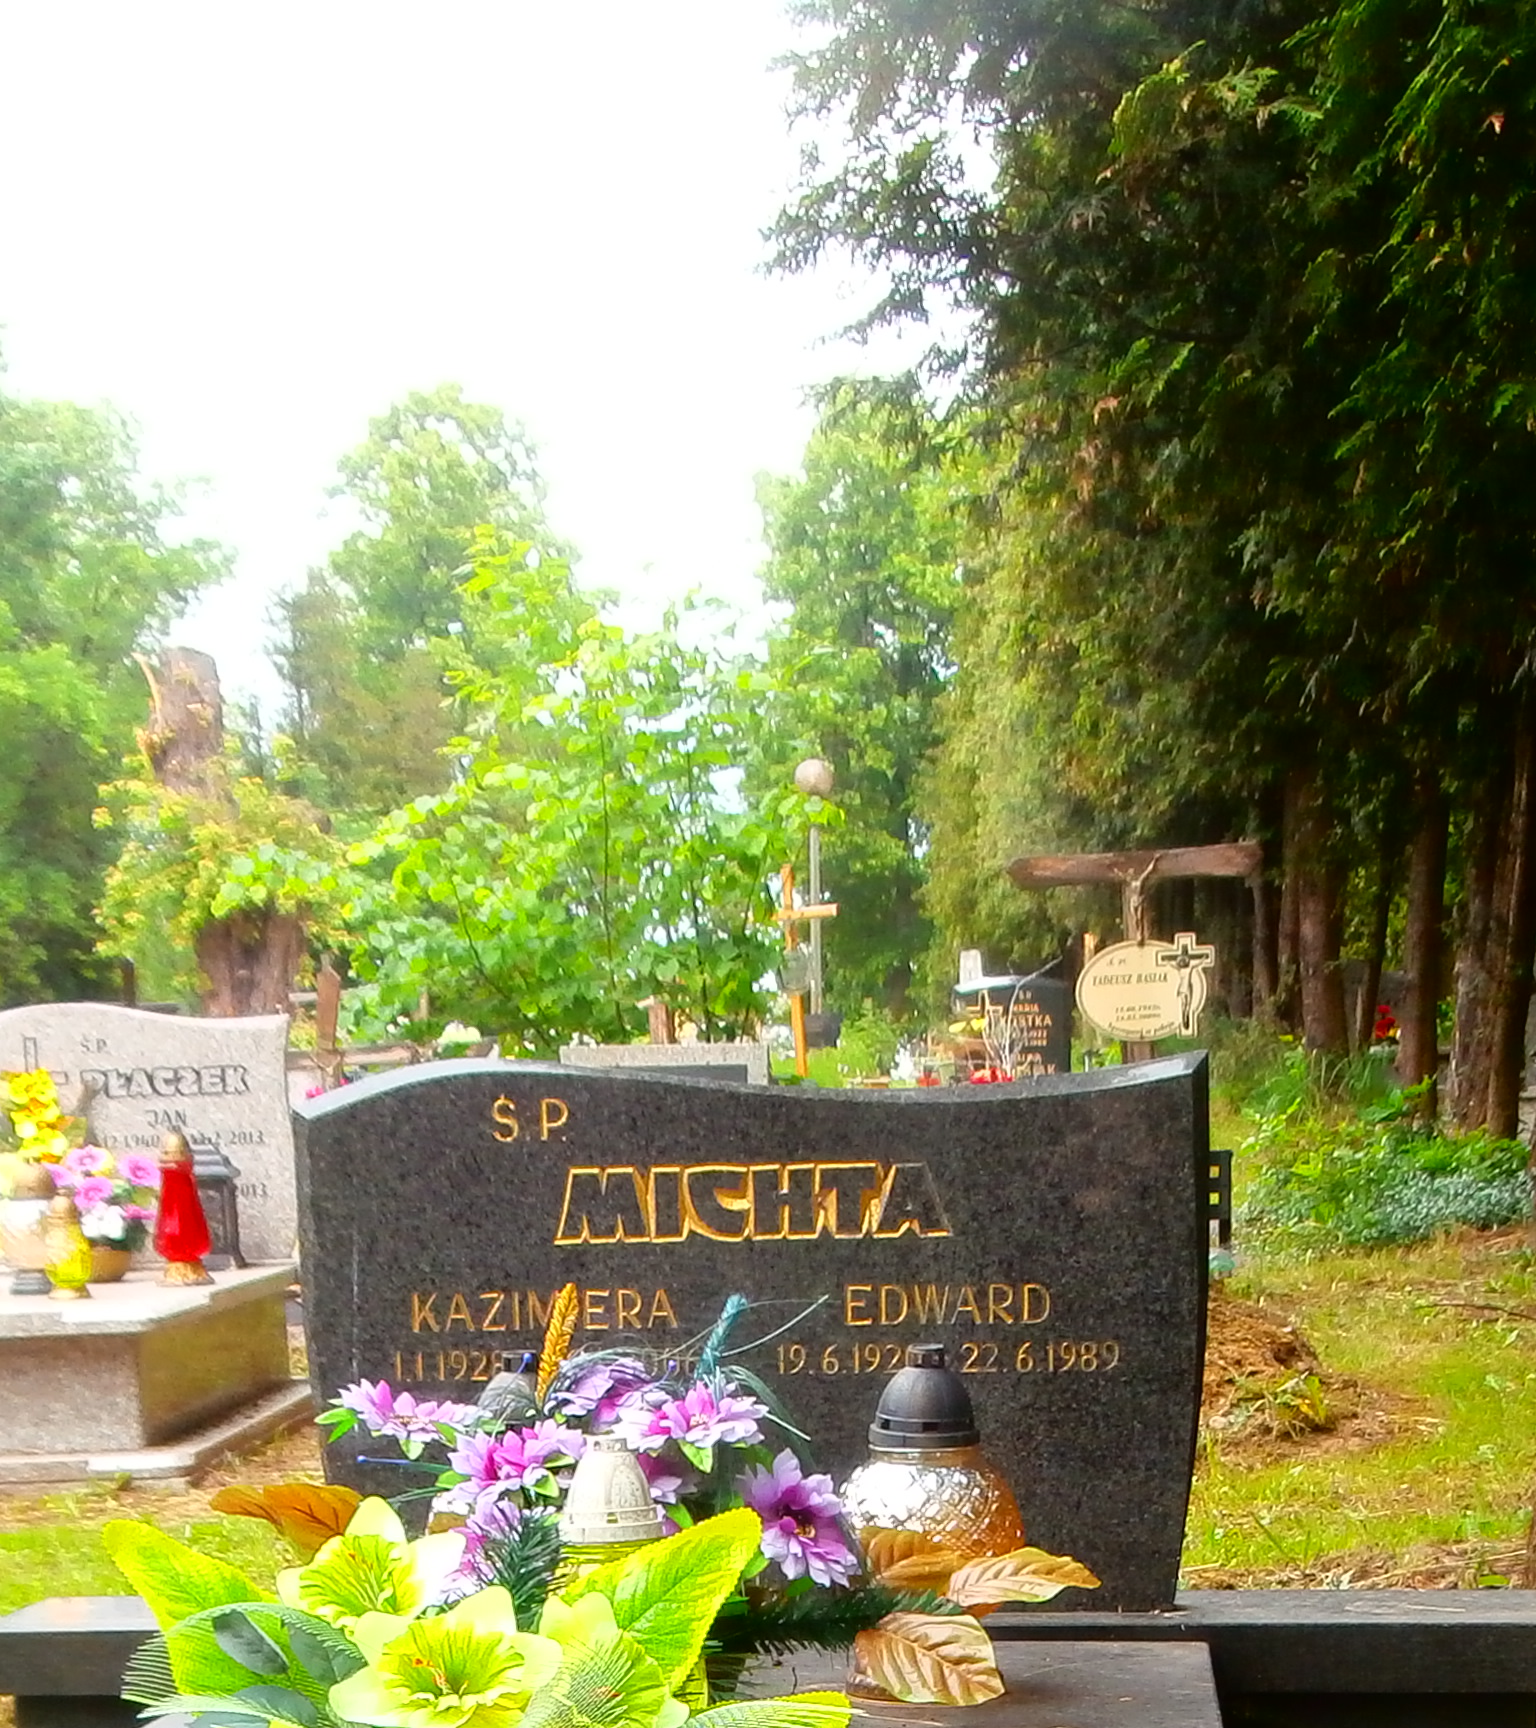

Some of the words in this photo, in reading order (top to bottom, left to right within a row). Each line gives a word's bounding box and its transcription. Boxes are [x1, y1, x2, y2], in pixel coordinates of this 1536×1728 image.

[1092, 973, 1133, 987] TADEUSZ
[80, 1065, 250, 1099] PŁACZEK
[145, 1110, 188, 1127] JAN
[554, 1161, 954, 1246] MICHTA
[410, 1287, 679, 1333] KAZIMERA
[843, 1282, 1052, 1327] EDWARD
[960, 1340, 1121, 1375] 22.6.1989
